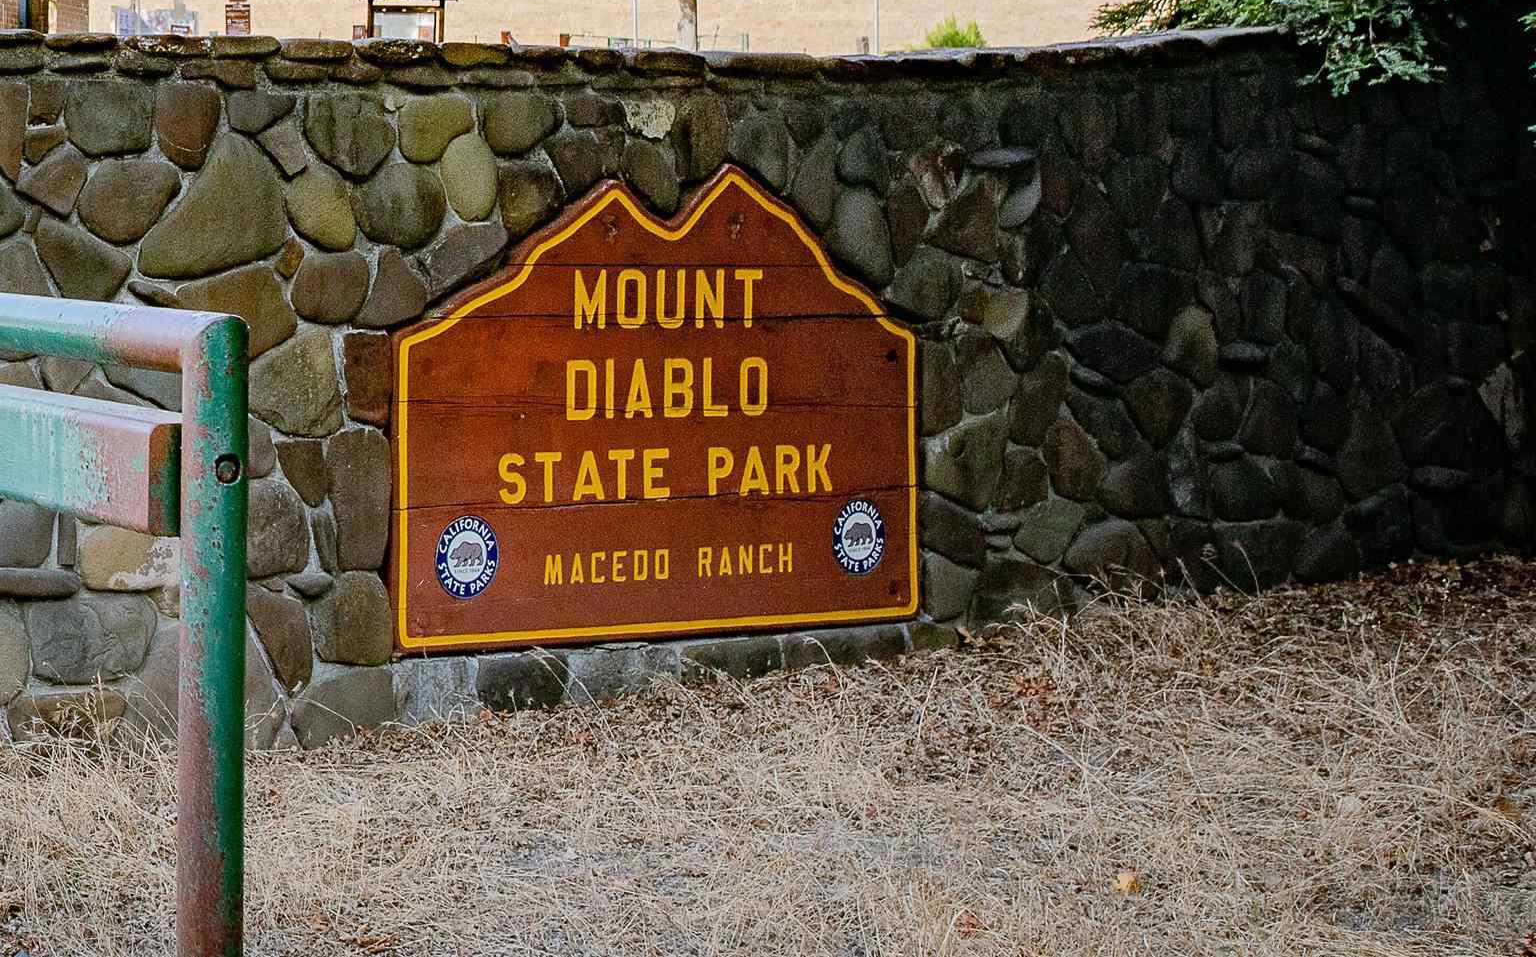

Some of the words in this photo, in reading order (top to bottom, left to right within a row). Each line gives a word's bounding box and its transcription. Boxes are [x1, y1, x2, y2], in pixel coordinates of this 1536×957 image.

[573, 268, 763, 330] MOUNT
[566, 357, 768, 421] DIABLO
[498, 447, 671, 505] STATE
[707, 443, 833, 496] PARK
[439, 518, 496, 554] CALIFORNIA
[834, 501, 882, 535] CALIFORNIA
[543, 549, 670, 585] MACEDO
[697, 543, 794, 578] RANCH
[834, 543, 859, 572] STATE
[862, 537, 884, 571] PARKS
[438, 562, 466, 595] STATE
[470, 559, 496, 594] PARKS
